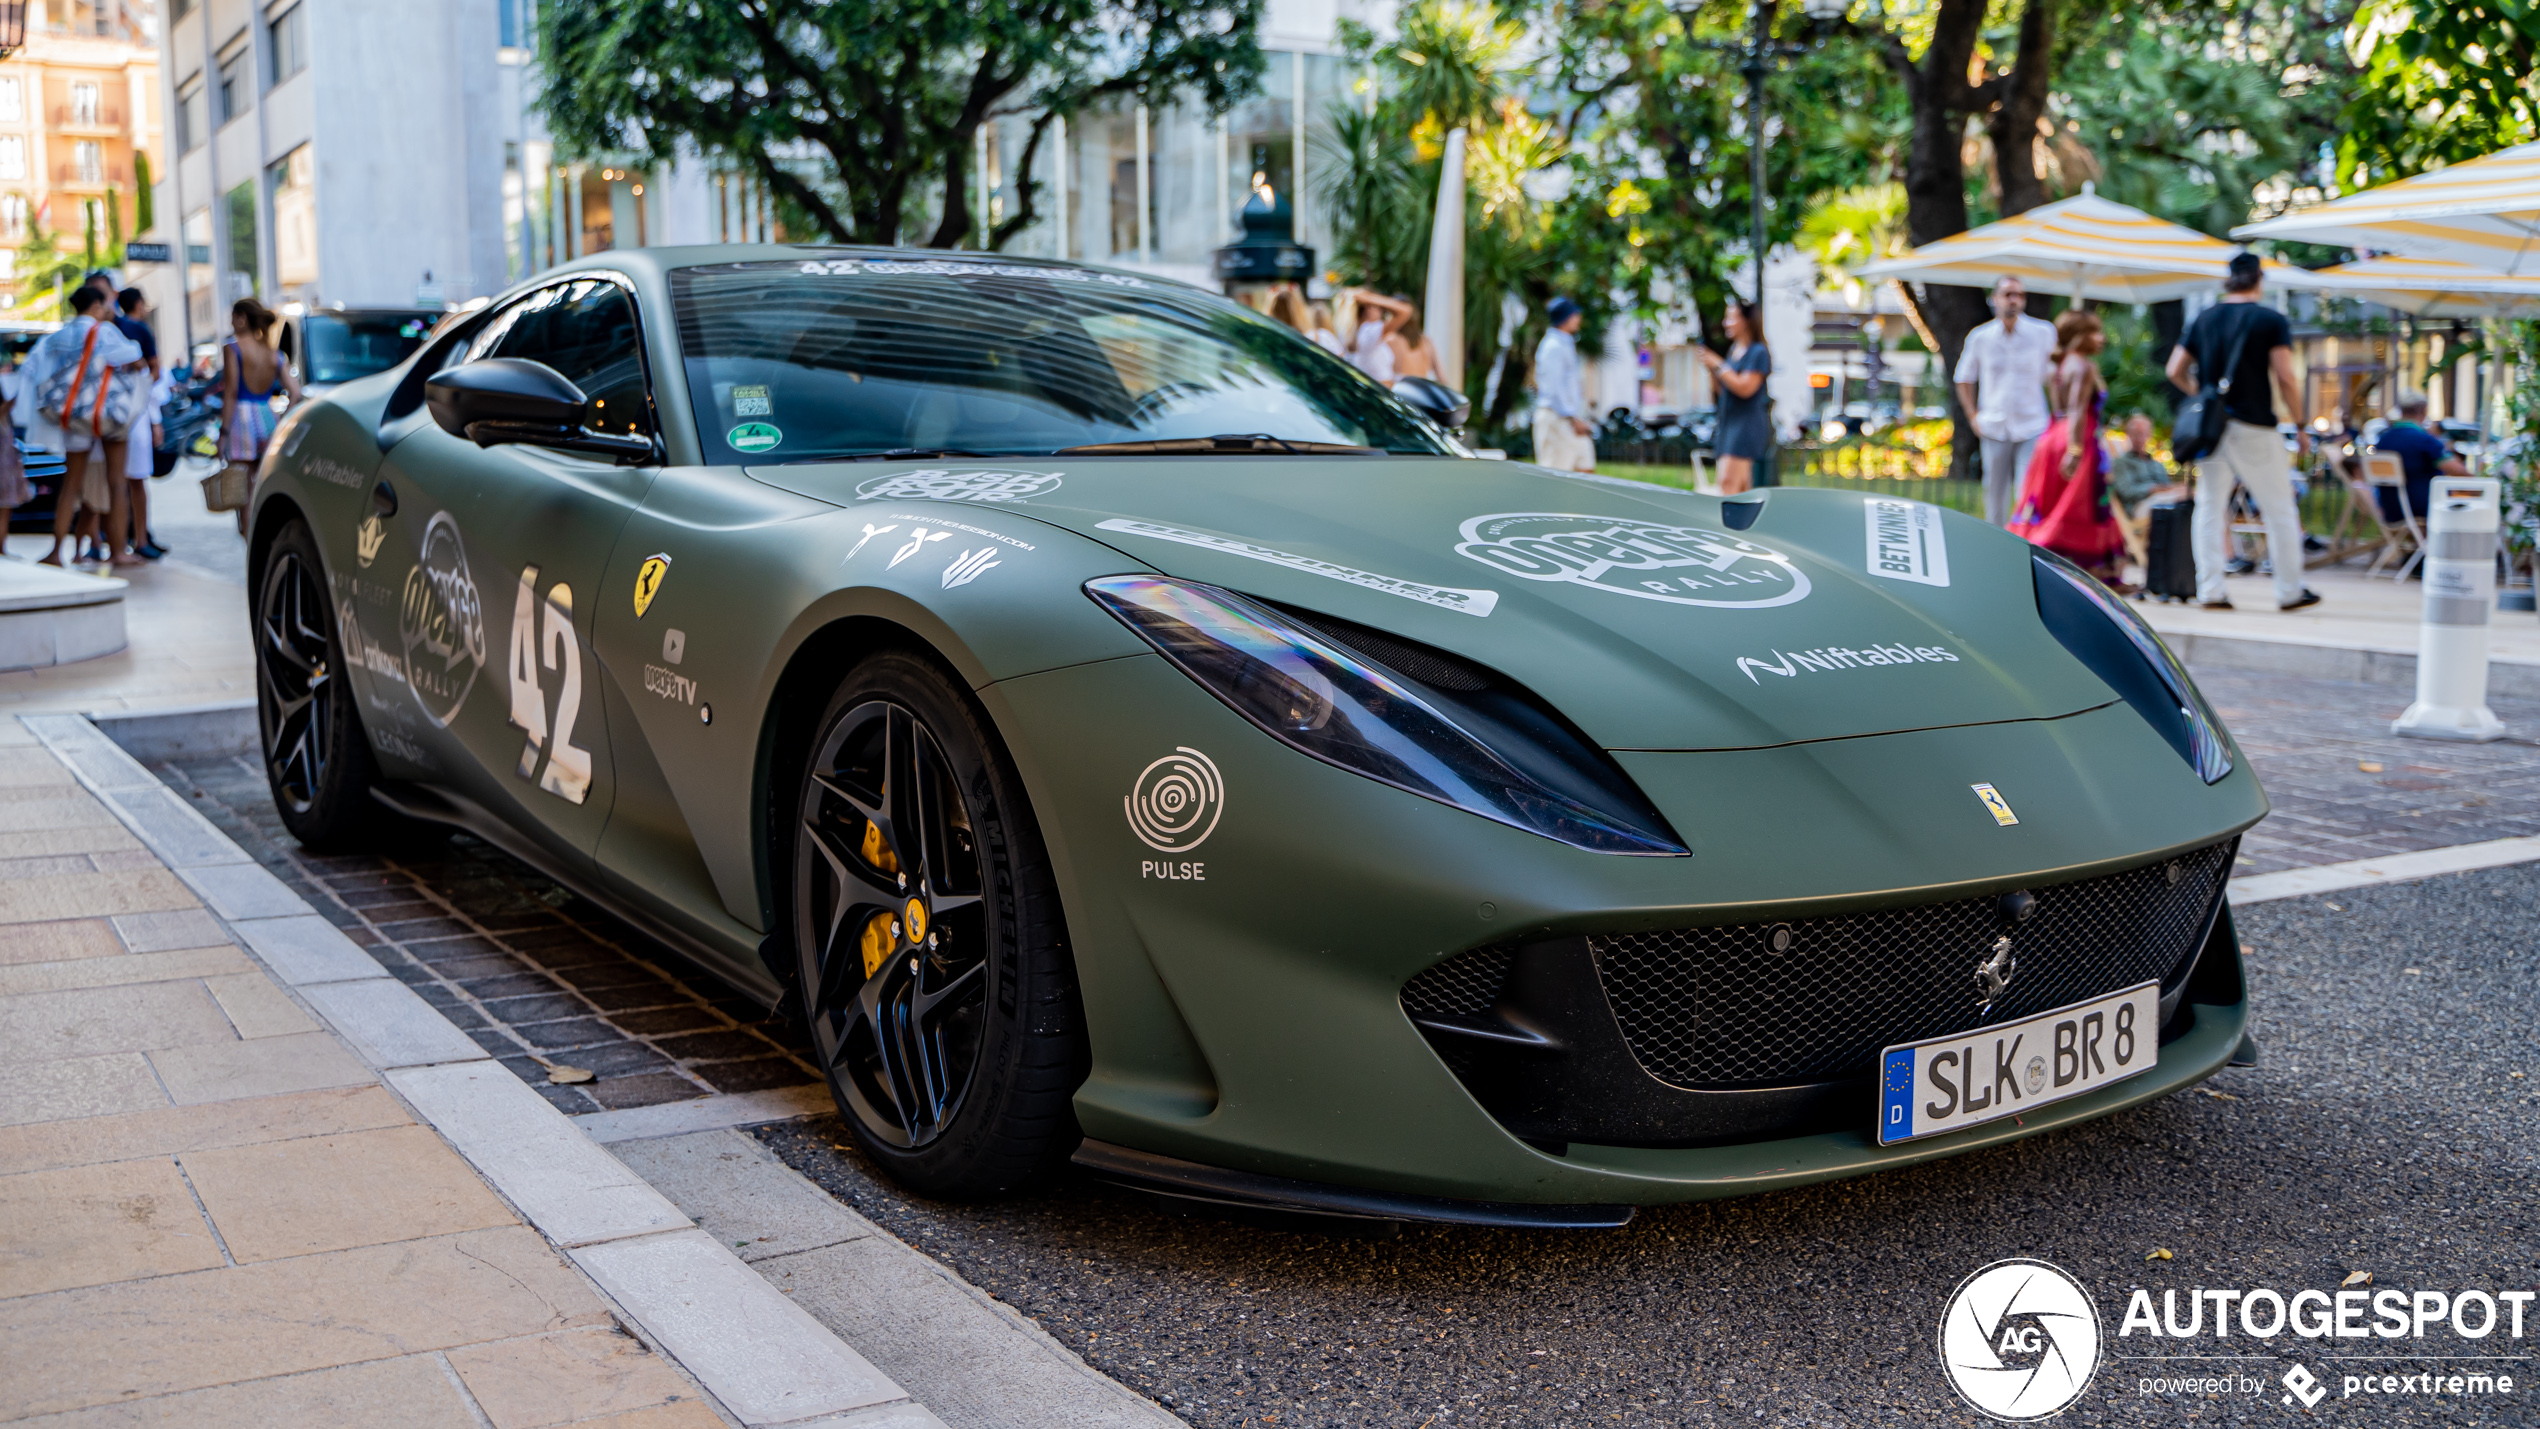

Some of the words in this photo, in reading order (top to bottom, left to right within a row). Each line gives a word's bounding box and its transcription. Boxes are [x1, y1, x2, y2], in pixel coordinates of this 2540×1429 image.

[800, 259, 860, 276] 42
[746, 424, 762, 437] 4
[314, 457, 366, 490] Niftables
[882, 477, 1040, 494] ROAD
[908, 469, 1066, 485] BASH
[855, 487, 1016, 502] TOUR
[1640, 569, 1784, 594] RALLY
[1787, 642, 1960, 673] Niftables
[414, 666, 461, 700] RALLY
[508, 563, 593, 805] 42
[1142, 860, 1206, 881] PULSE
[985, 819, 1019, 1013] MICHELIN
[994, 1029, 1011, 1077] PILOT
[1926, 1033, 2023, 1120] SLK
[2054, 1010, 2105, 1088] BR
[2114, 1002, 2135, 1066] 8
[1890, 1104, 1903, 1125] D
